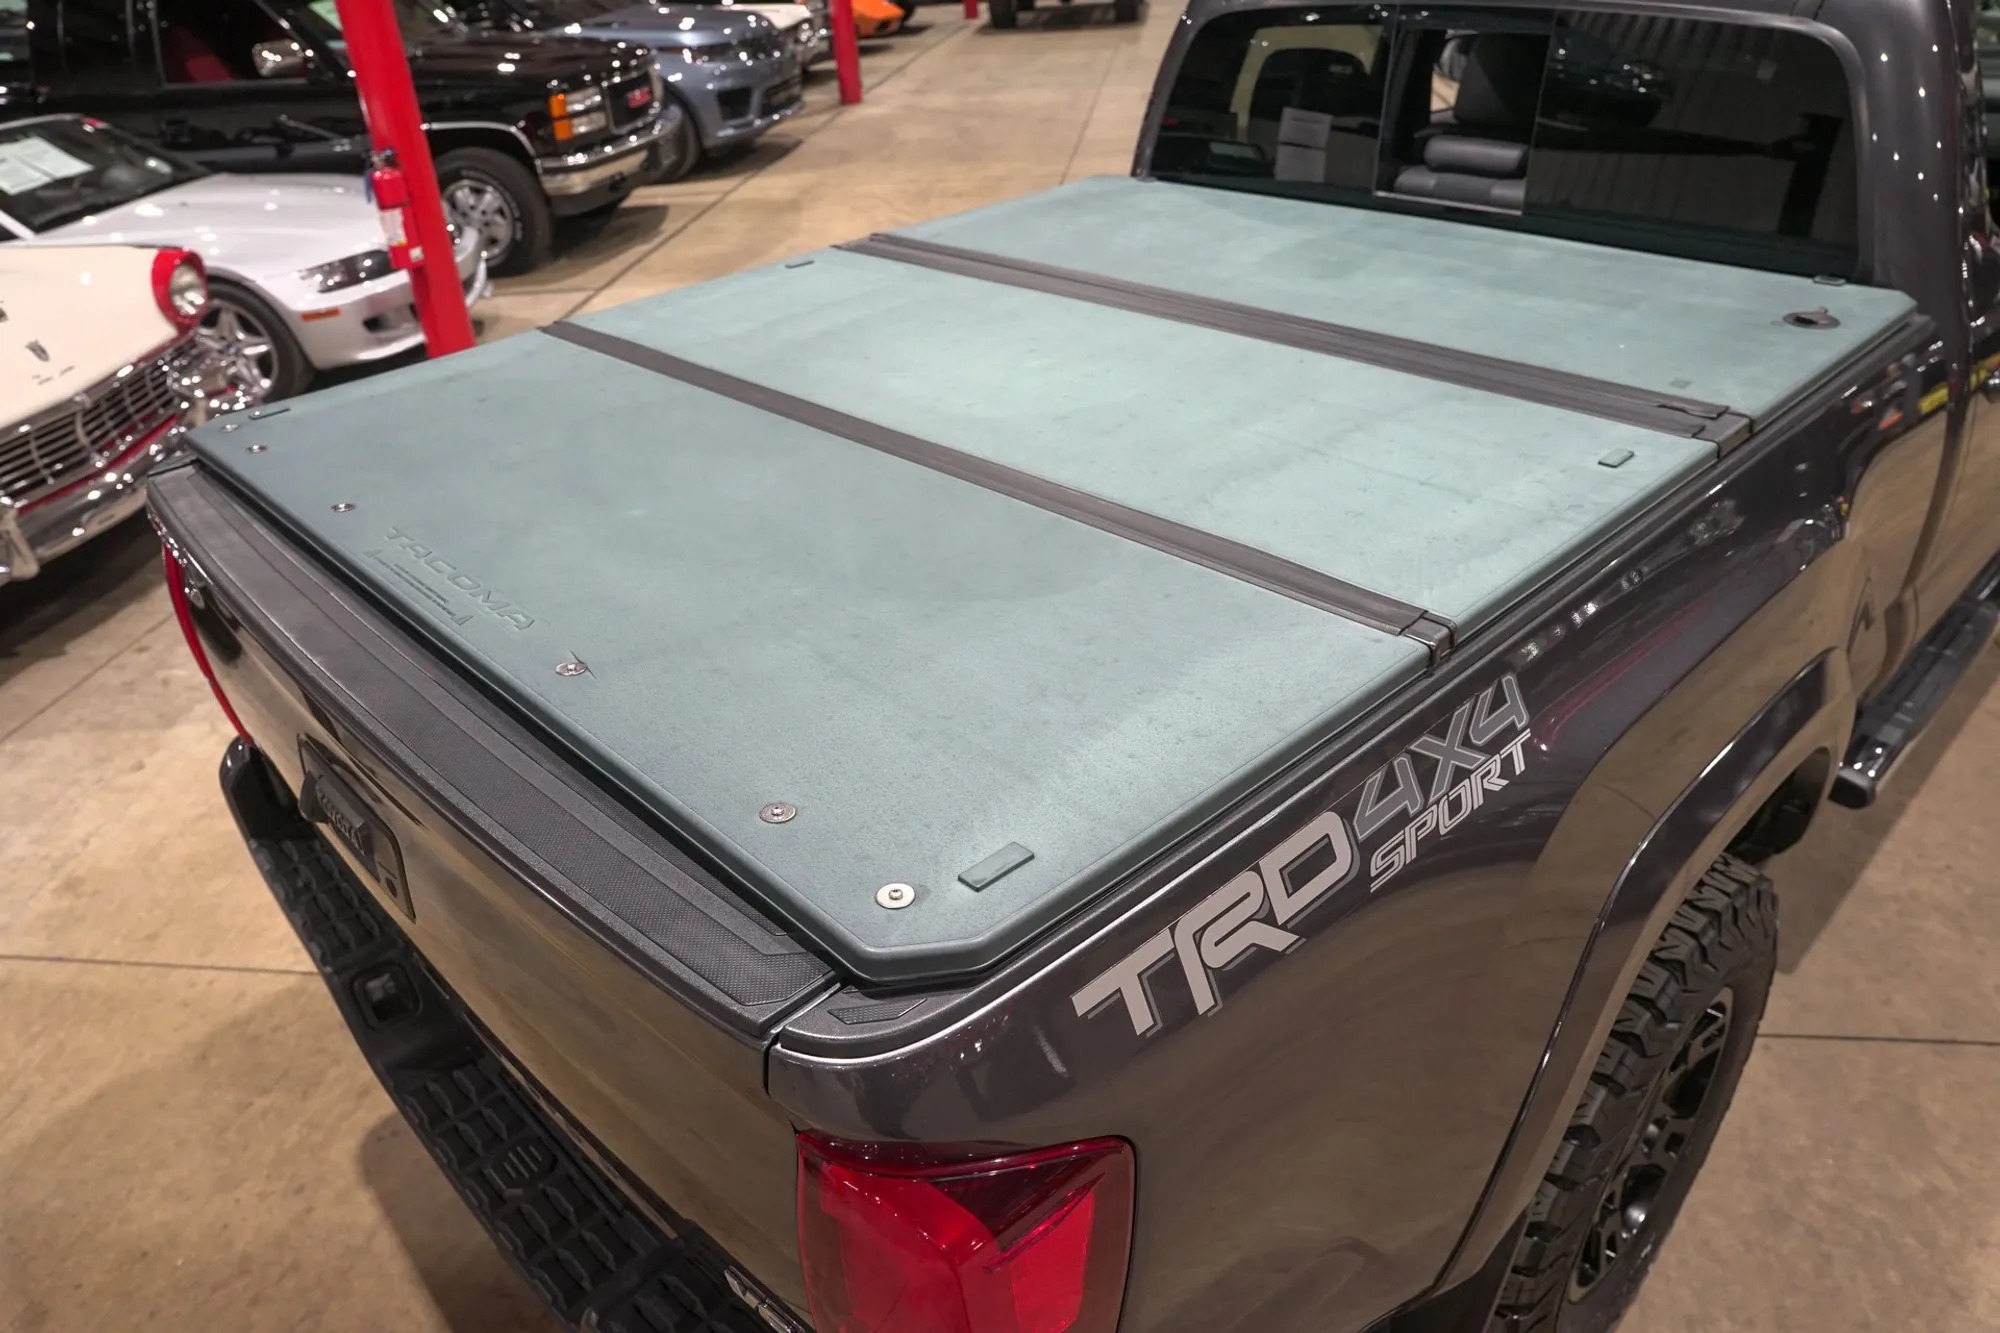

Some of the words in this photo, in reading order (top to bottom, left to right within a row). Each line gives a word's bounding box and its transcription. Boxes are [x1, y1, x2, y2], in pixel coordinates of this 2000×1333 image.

[385, 526, 536, 630] TACOMA
[1070, 811, 1361, 1038] TRD
[1352, 672, 1531, 842] 4X4
[1369, 728, 1532, 893] SPORT
